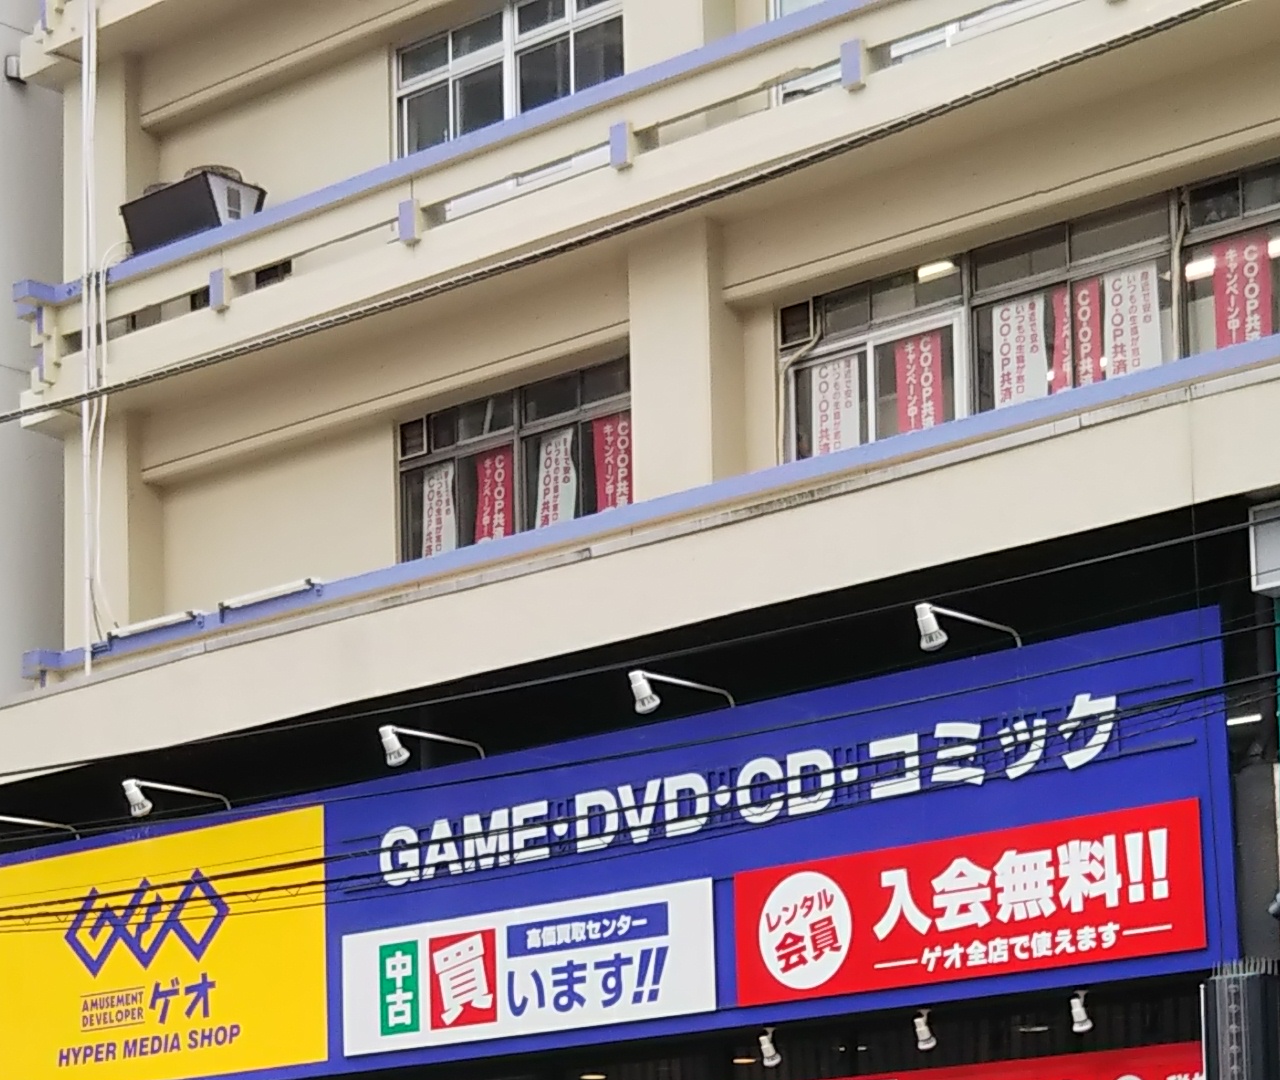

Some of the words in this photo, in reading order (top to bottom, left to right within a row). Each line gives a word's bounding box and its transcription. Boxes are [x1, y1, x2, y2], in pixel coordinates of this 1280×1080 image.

[873, 827, 1170, 941] 入会無料!!
[64, 867, 230, 978] GEO
[526, 915, 648, 949] 高価買取センター
[765, 888, 835, 933] レンタル
[775, 919, 842, 974] 会員
[920, 923, 1120, 973] ゲオ全店で使えます
[81, 990, 144, 1013] AMUSEMENT
[149, 972, 216, 1025] ゲオ
[385, 950, 413, 1028] 中古
[81, 1006, 144, 1028] DEVELOPER
[58, 1042, 117, 1067] HYPER
[122, 1032, 181, 1059] MEDIA
[187, 1024, 241, 1049] SHOP
